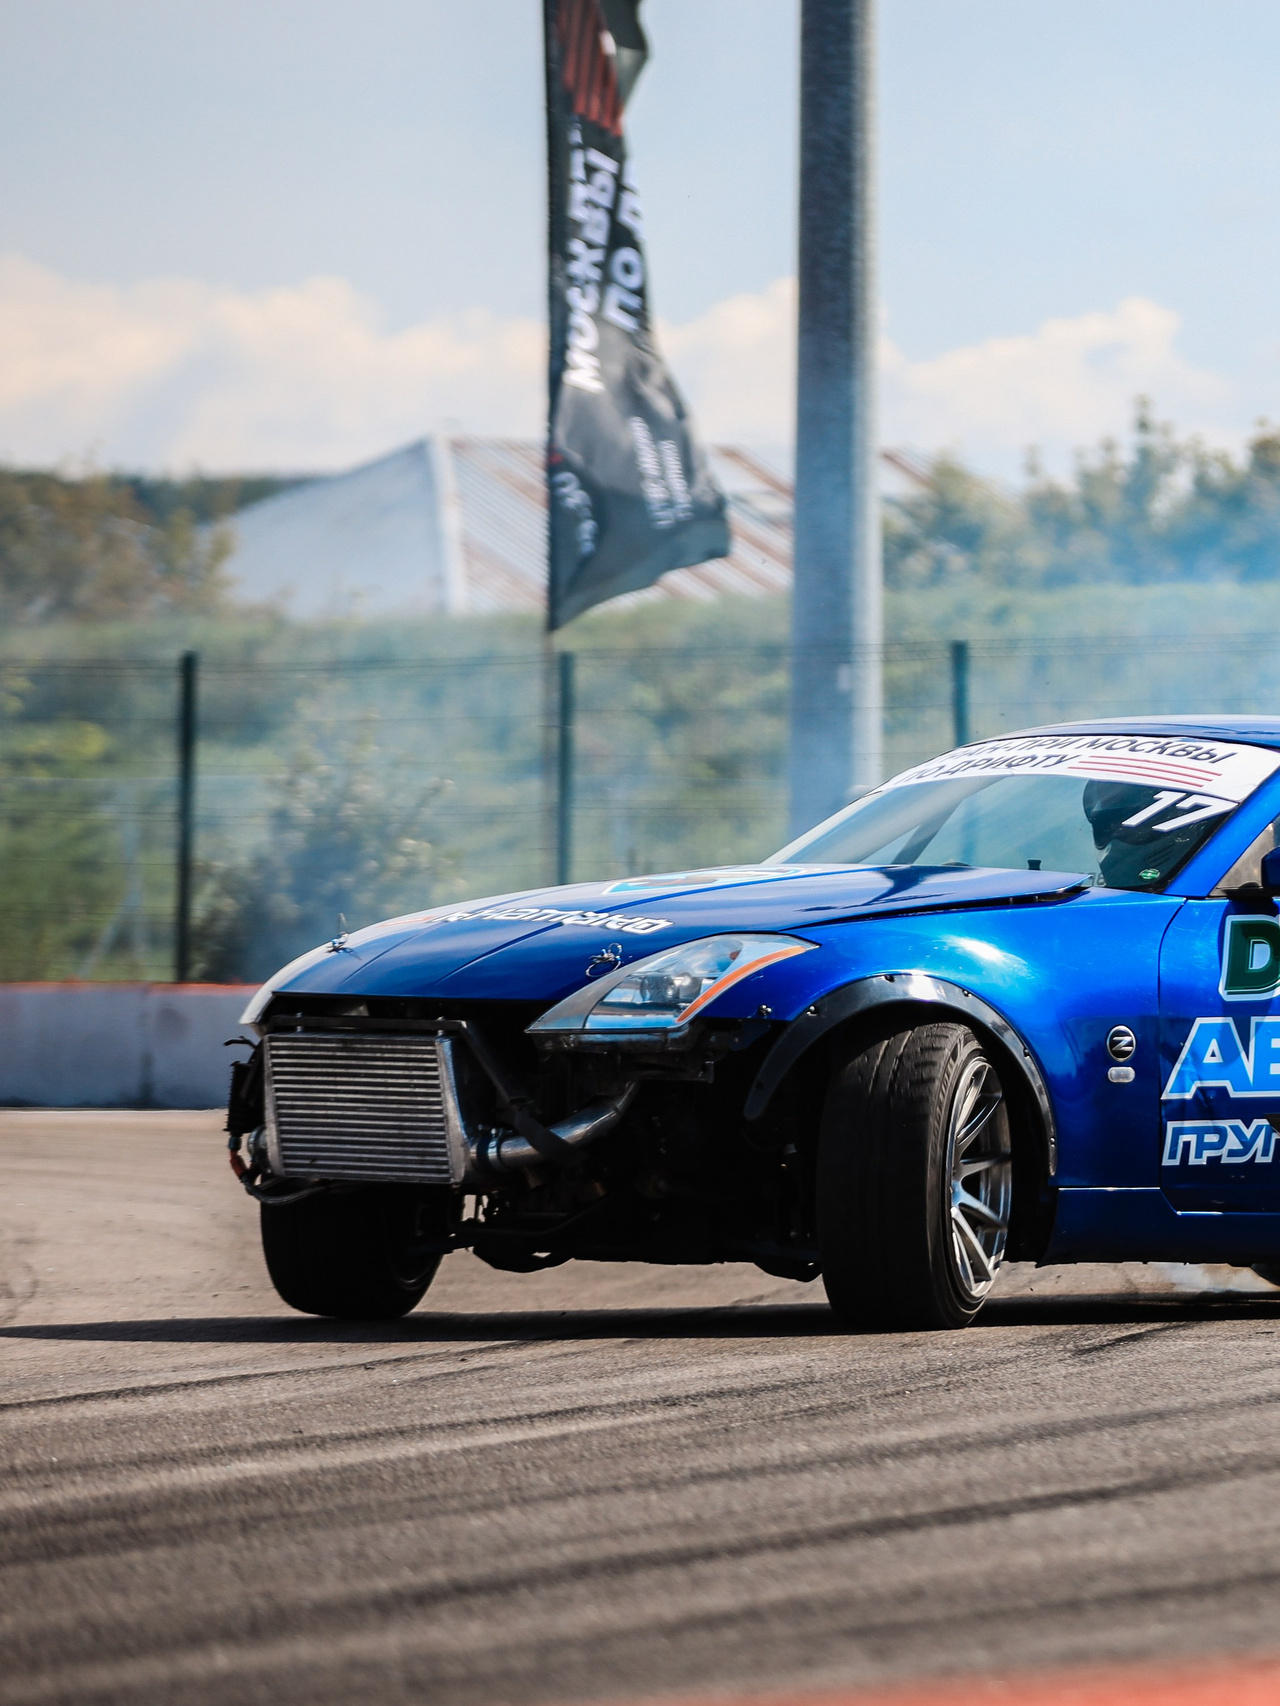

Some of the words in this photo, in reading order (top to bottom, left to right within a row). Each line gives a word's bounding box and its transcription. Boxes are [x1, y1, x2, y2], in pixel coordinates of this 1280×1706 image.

[1078, 737, 1238, 764] МОСКВЫ
[933, 754, 1081, 778] ДРИФТУ
[1120, 790, 1240, 832] 17
